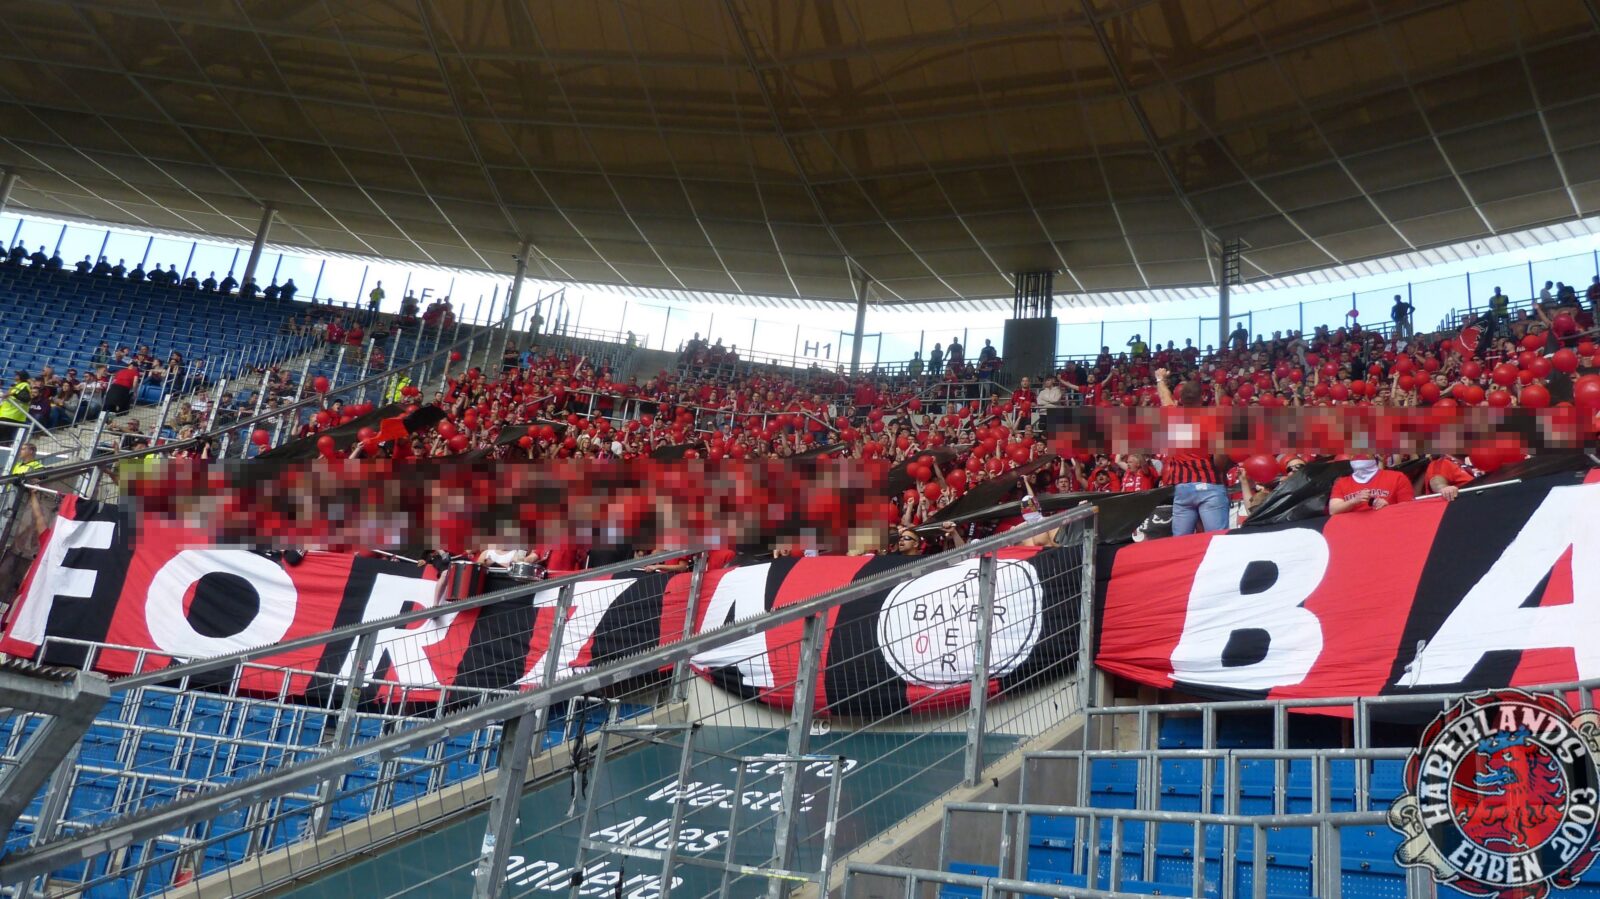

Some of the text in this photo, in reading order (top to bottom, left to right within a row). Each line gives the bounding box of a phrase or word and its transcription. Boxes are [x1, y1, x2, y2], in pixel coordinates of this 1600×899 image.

[420, 287, 435, 304] F
[803, 340, 832, 360] H1
[8, 515, 776, 688] FORZA
[912, 603, 1007, 624] BAYER
[589, 815, 730, 851] Alles
